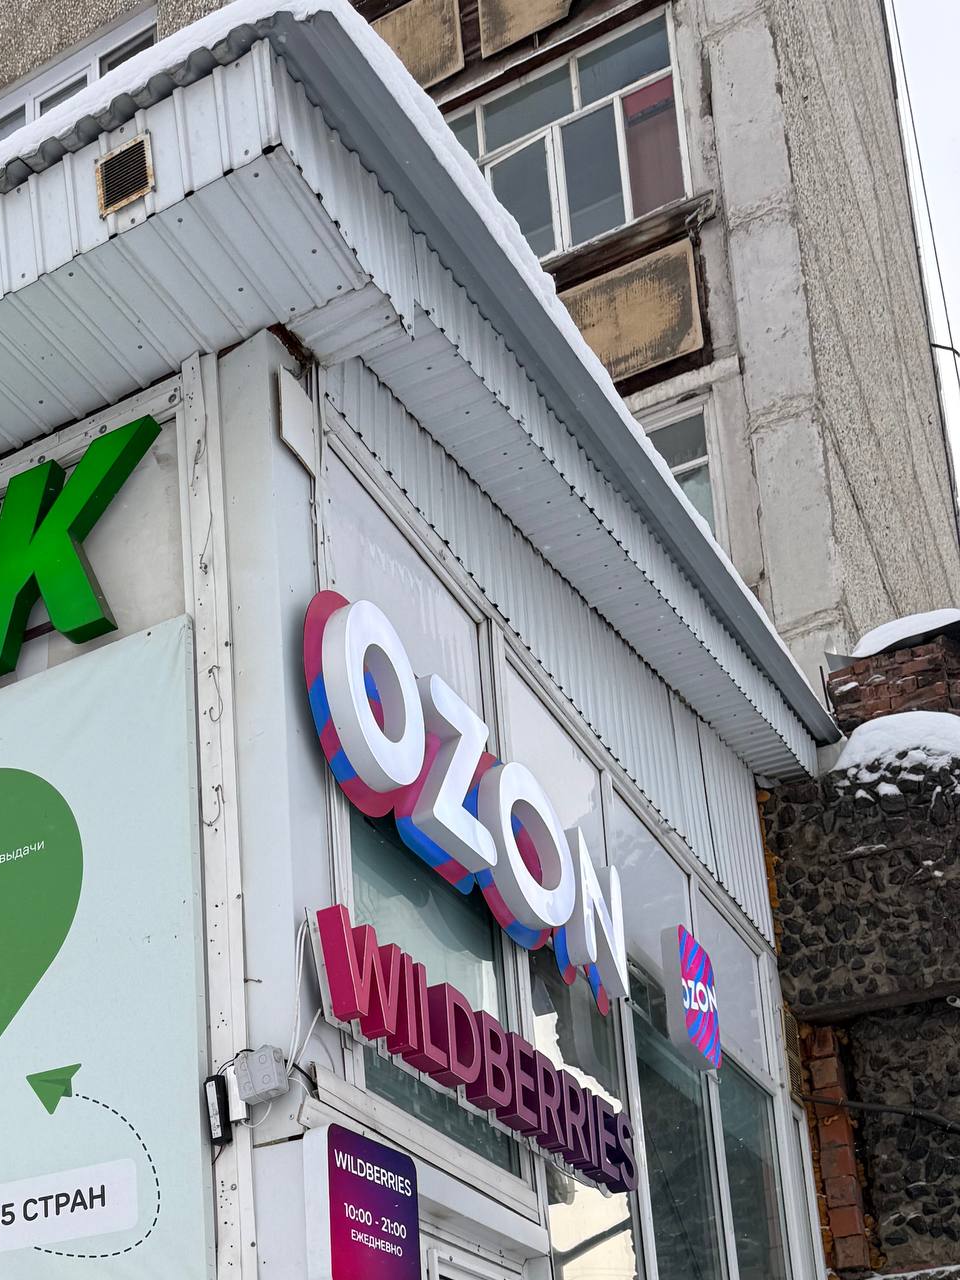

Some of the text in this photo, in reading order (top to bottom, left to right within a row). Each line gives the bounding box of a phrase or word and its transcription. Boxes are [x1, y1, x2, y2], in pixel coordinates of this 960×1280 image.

[310, 592, 629, 1002] OZON
[317, 903, 640, 1193] WILDBERRIES
[334, 1149, 412, 1197] WILDBERRIES
[22, 1184, 106, 1222] СТРАН
[343, 1202, 373, 1226] 10:00
[381, 1216, 407, 1239] 21:00
[351, 1229, 403, 1257] ЕЖЕДНЕВНО
